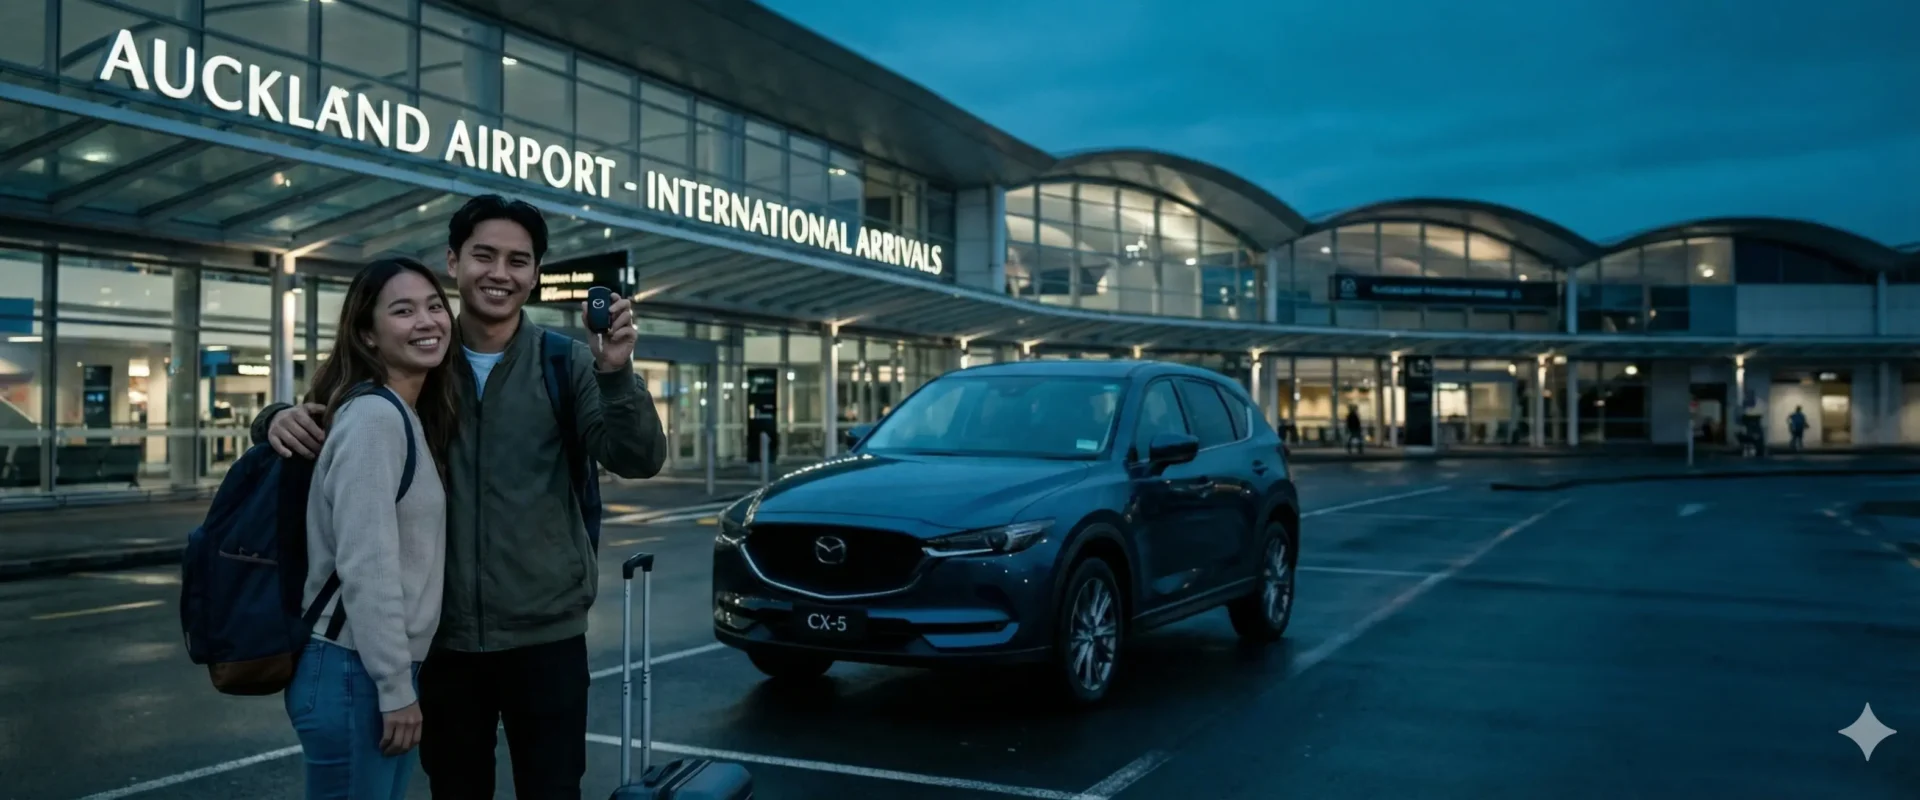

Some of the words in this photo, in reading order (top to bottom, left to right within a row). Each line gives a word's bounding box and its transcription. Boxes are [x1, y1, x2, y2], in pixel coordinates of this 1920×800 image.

[100, 28, 430, 154] AUCKLAND
[444, 119, 617, 198] AIRPORT
[647, 170, 853, 255] INTERNATIONAL
[855, 226, 943, 275] ARRIVALS
[807, 613, 847, 632] CX-5
